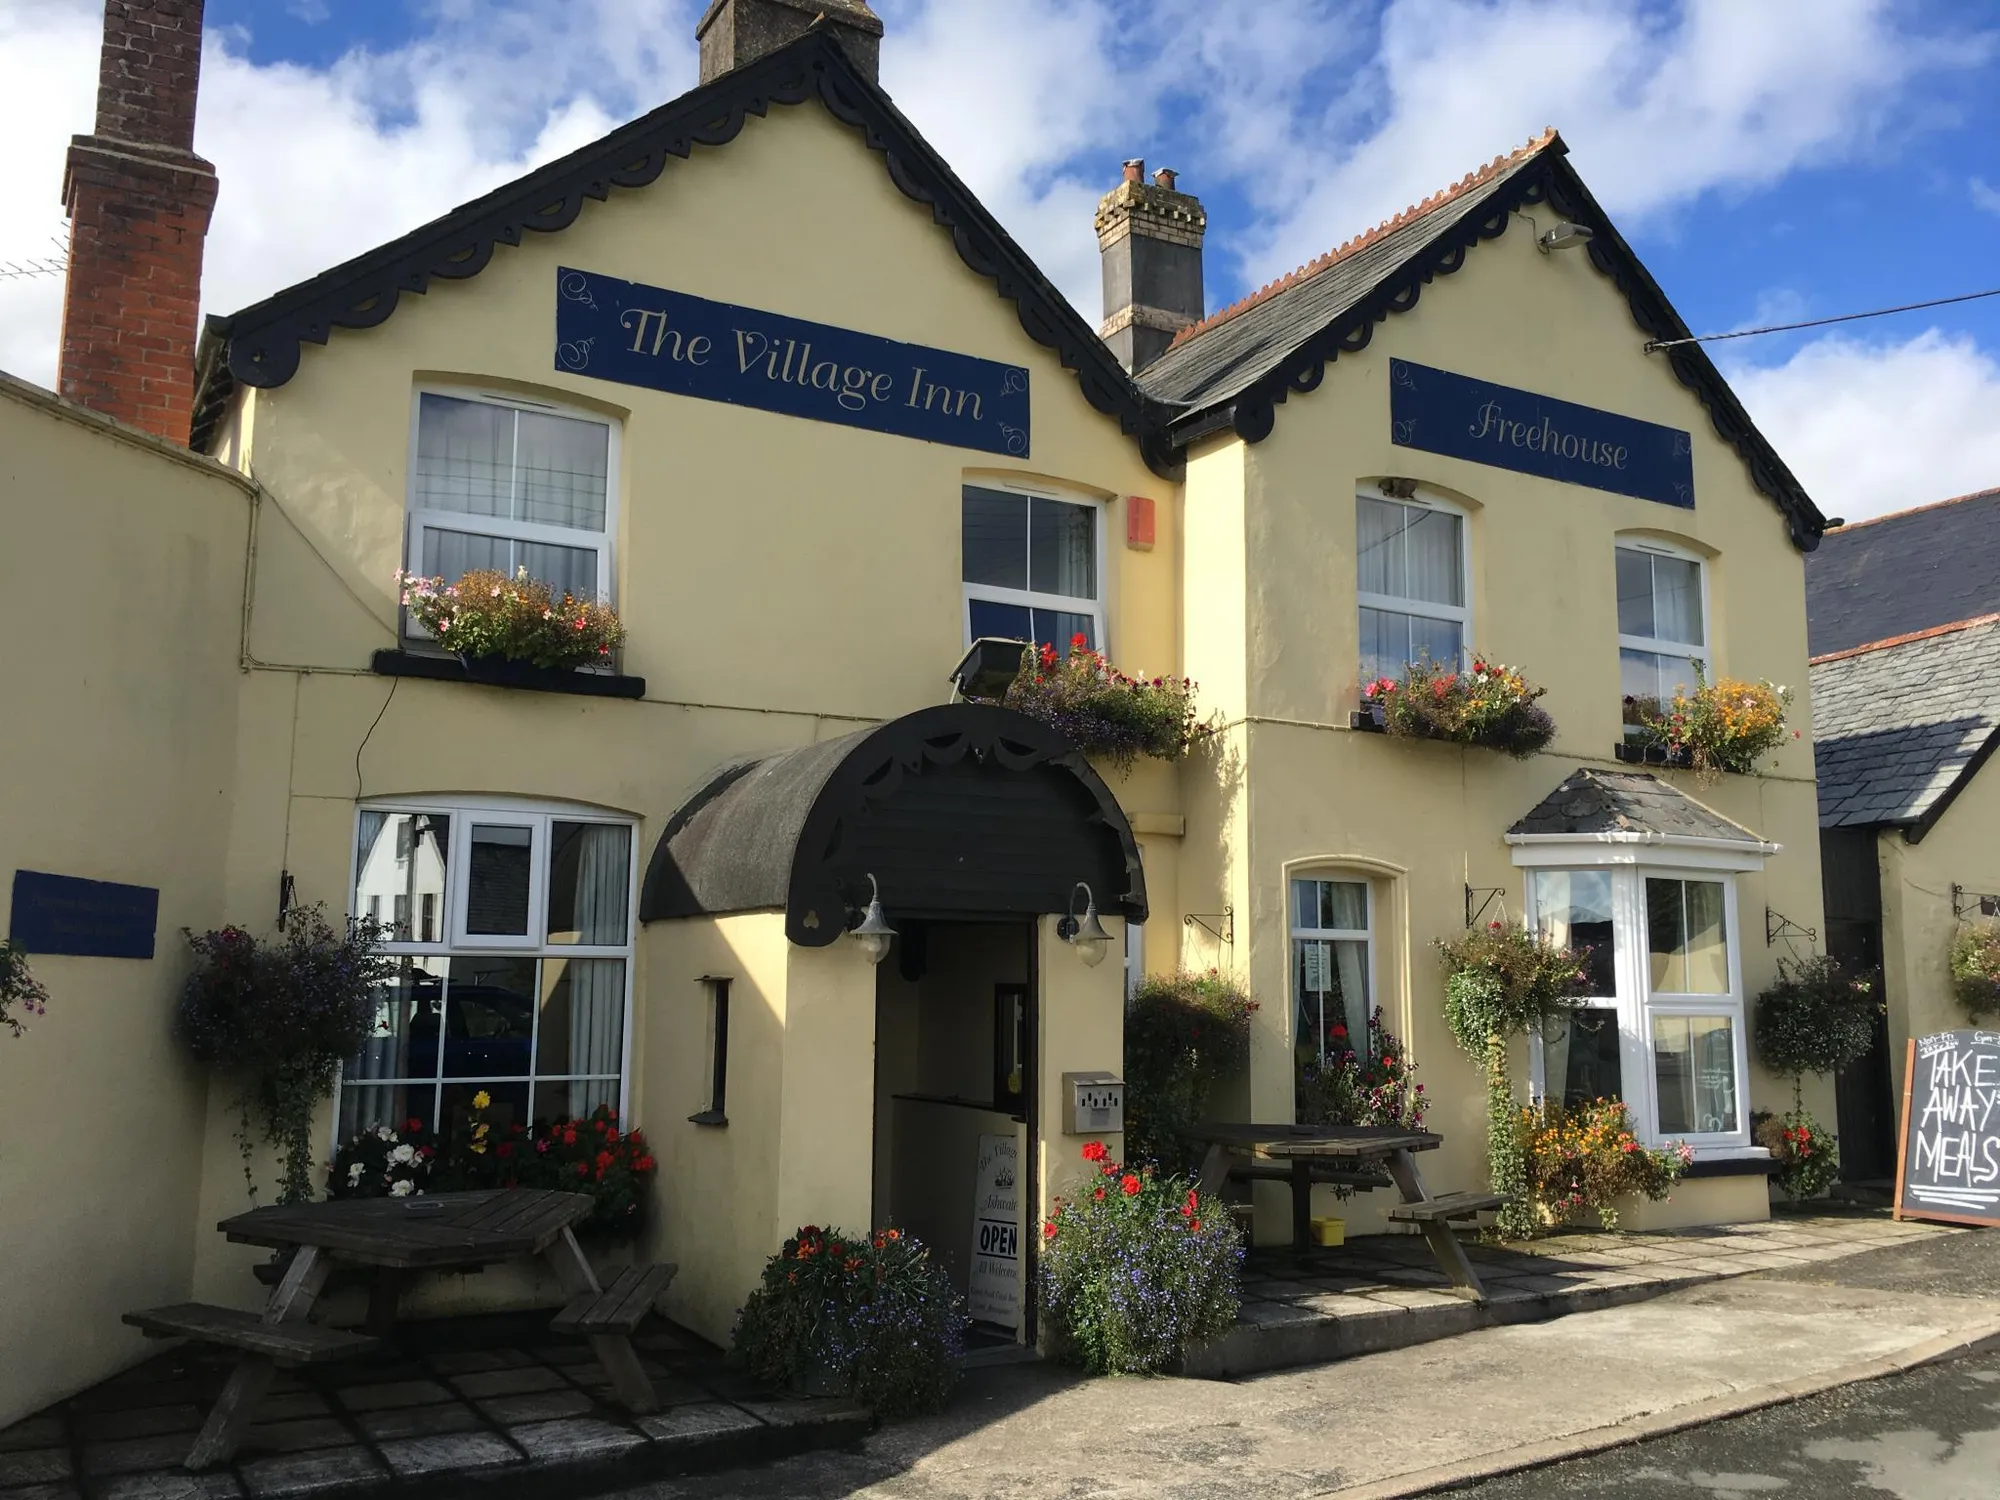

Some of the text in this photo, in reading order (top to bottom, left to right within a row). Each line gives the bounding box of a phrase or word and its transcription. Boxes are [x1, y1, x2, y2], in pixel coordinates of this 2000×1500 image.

[620, 308, 983, 421] The Village Inn
[1469, 400, 1628, 470] Freehouse
[1922, 1046, 1998, 1091] TAKE
[1921, 1084, 1996, 1133] AWAY
[1915, 1130, 2000, 1187] MEALS
[980, 1225, 1017, 1256] OPEN
